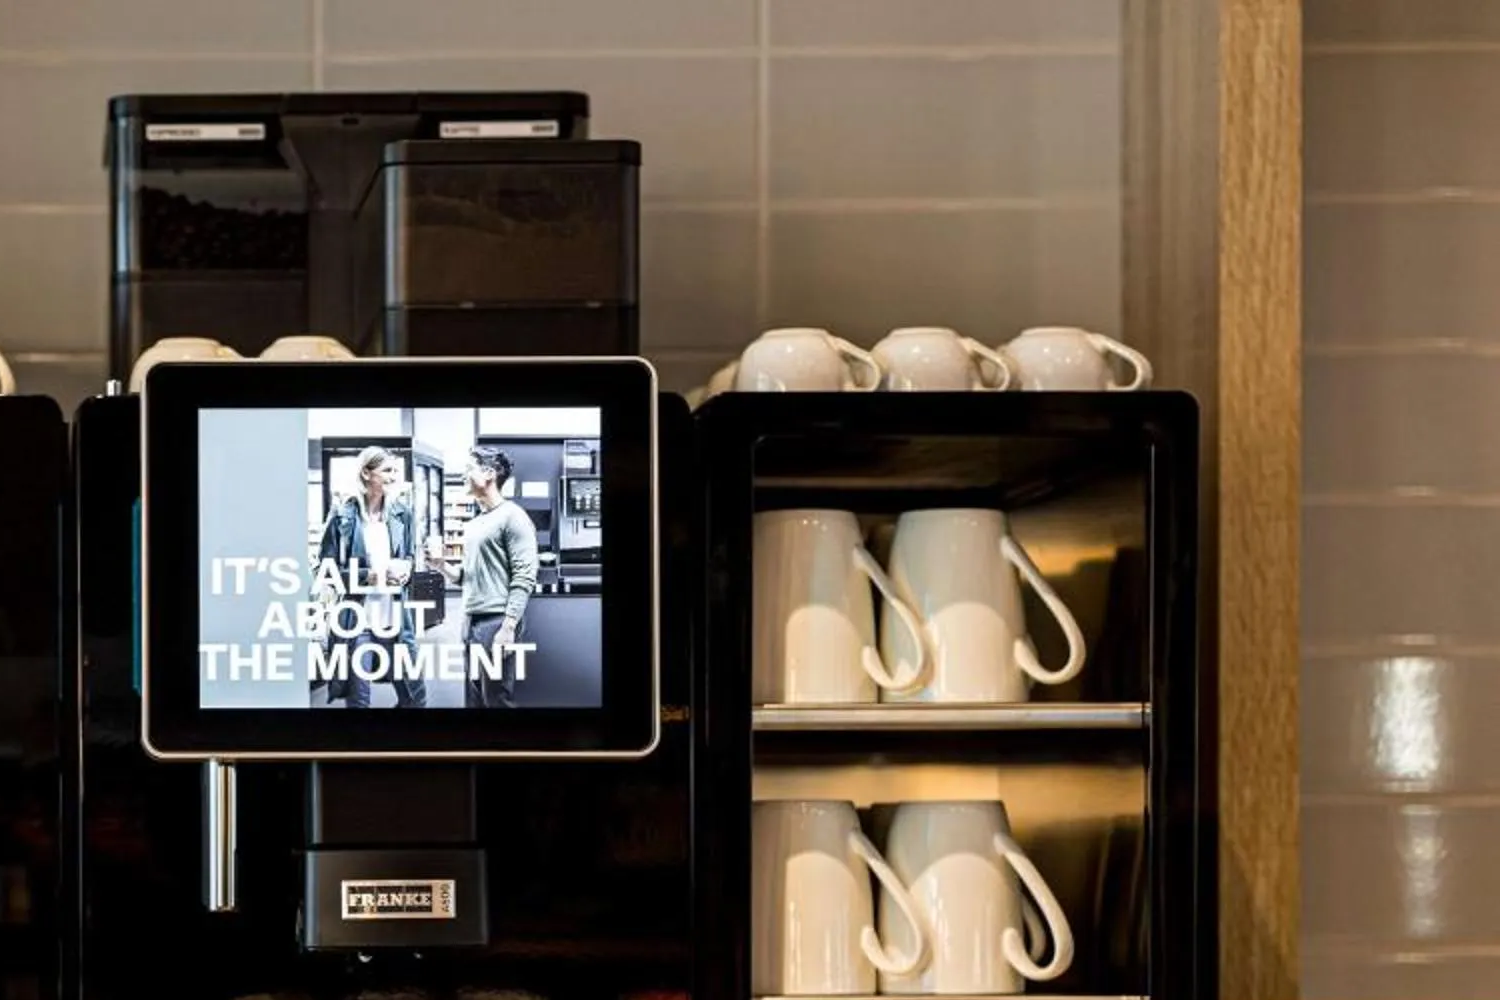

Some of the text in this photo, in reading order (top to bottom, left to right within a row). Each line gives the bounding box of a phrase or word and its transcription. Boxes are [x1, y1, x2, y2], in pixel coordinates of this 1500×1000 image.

[311, 556, 411, 594] ALL
[258, 602, 435, 638] ABOUT
[198, 643, 536, 681] THE MOMENT
[349, 892, 431, 907] FRANKE
